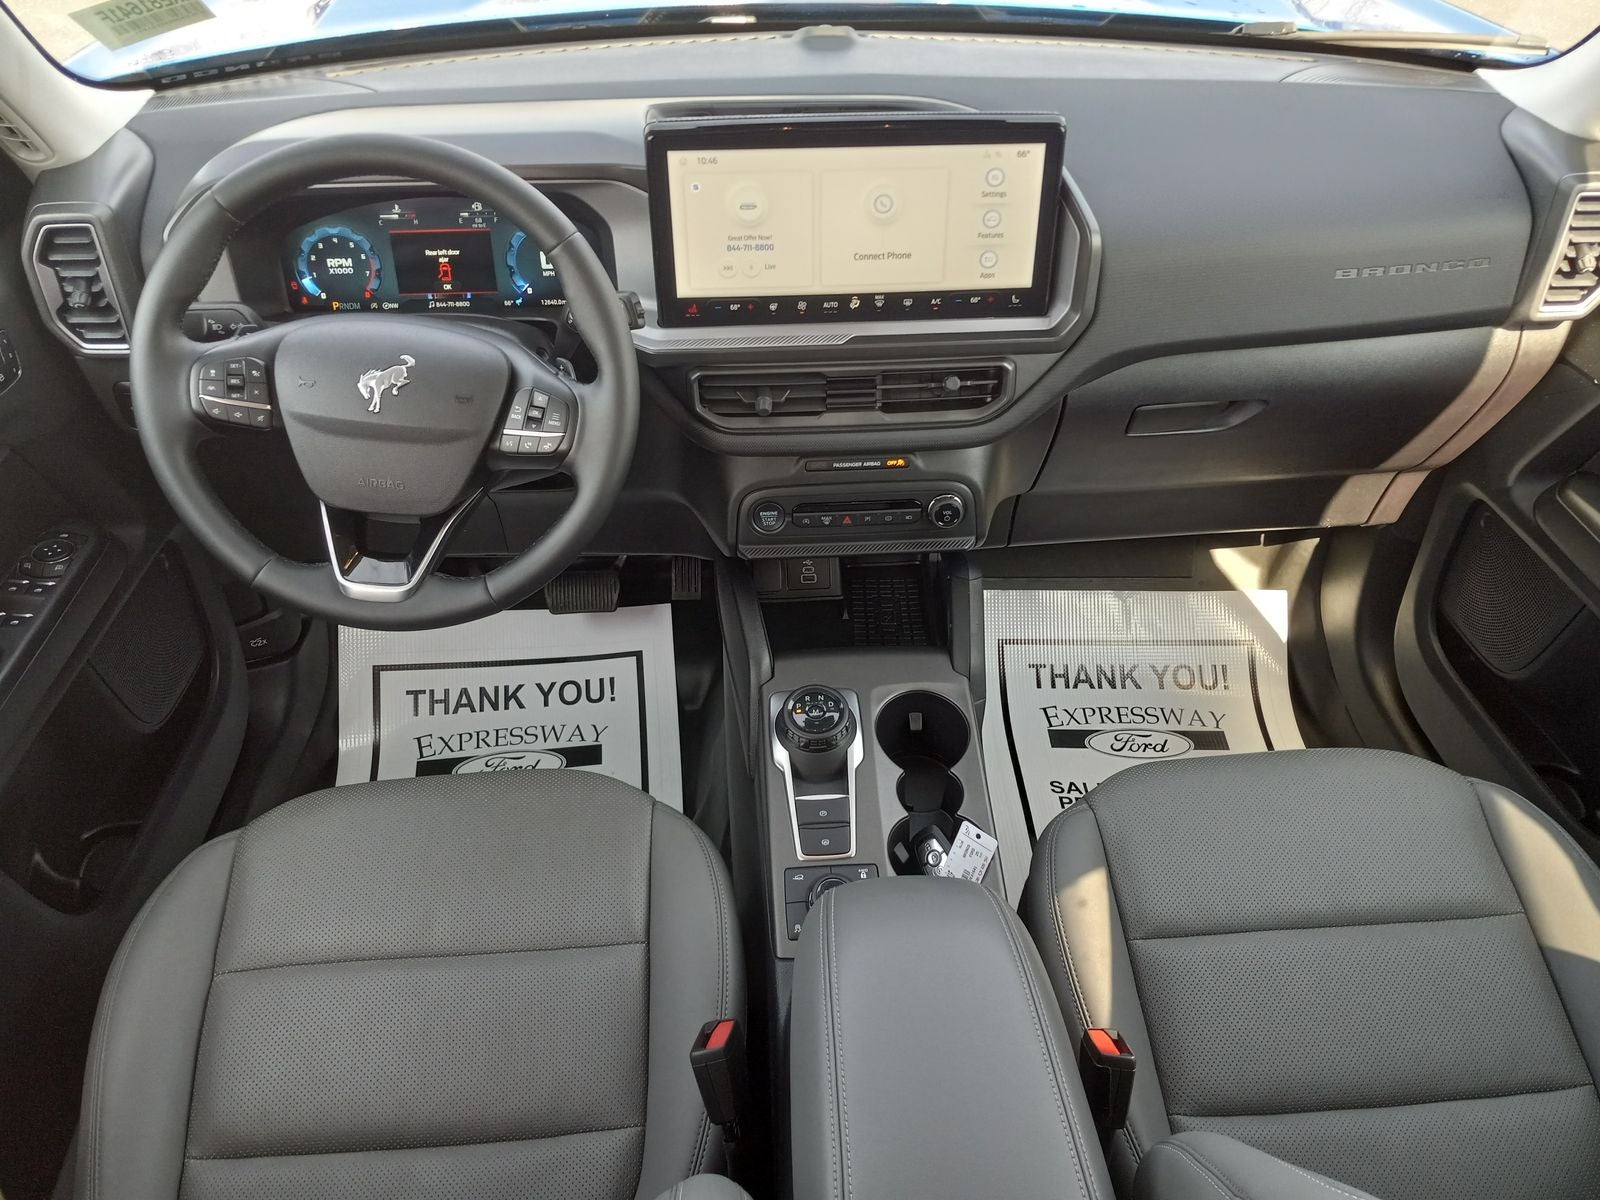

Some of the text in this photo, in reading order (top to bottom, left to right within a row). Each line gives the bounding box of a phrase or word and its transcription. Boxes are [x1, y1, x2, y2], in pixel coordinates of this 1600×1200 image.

[326, 258, 353, 268] RPM
[853, 253, 885, 261] Connect
[1335, 257, 1490, 279] BRONCO
[1028, 664, 1229, 690] THANK YOU!
[406, 676, 617, 718] THANK YOU!
[1110, 733, 1169, 754] Ford
